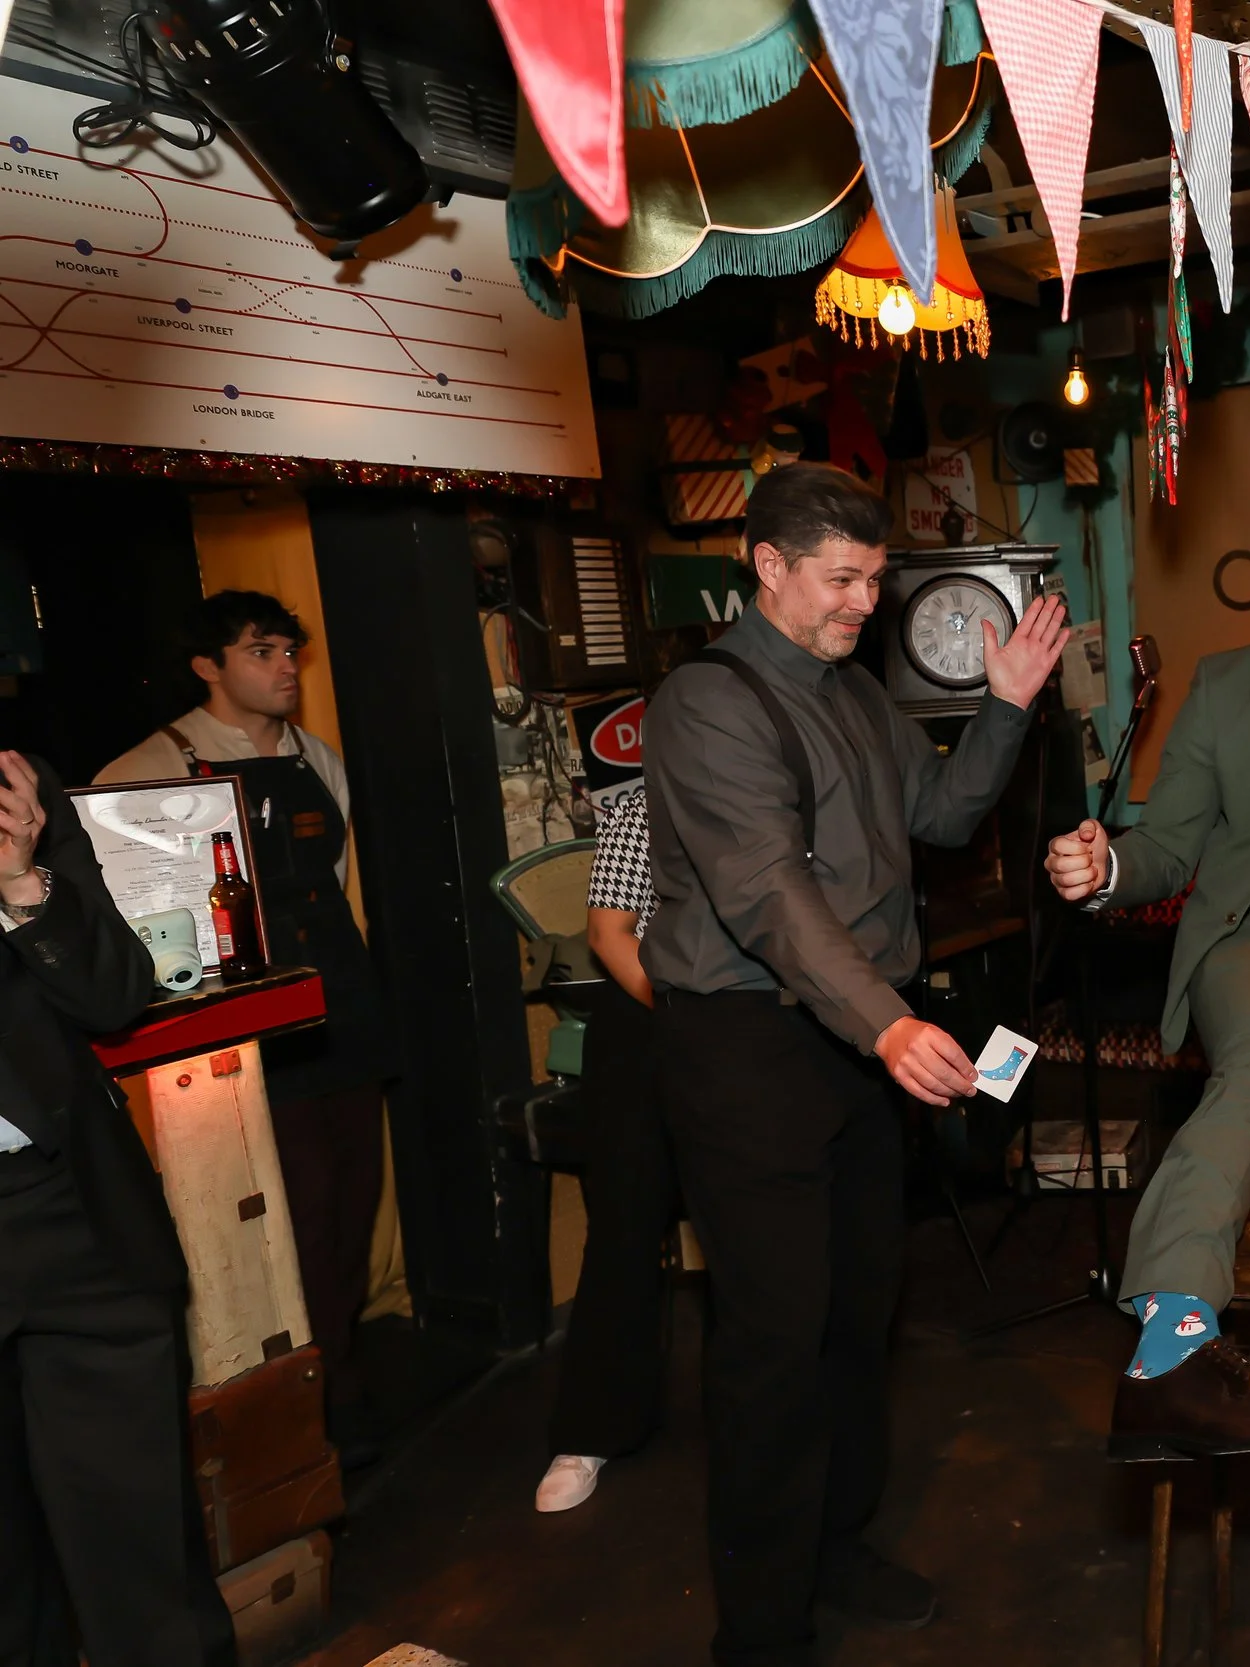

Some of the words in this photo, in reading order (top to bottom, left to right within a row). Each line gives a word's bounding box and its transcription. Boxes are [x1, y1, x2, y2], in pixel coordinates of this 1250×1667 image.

[17, 164, 59, 180] STREET
[55, 260, 119, 278] MOORGATE
[137, 315, 195, 331] LIVERPOOL
[198, 324, 234, 336] STREET
[416, 390, 451, 401] ALDGATE
[454, 394, 472, 402] EAST
[192, 404, 237, 416] LONDON
[241, 409, 275, 419] BRIDGE
[910, 509, 974, 533] SMOG
[616, 718, 642, 751] D
